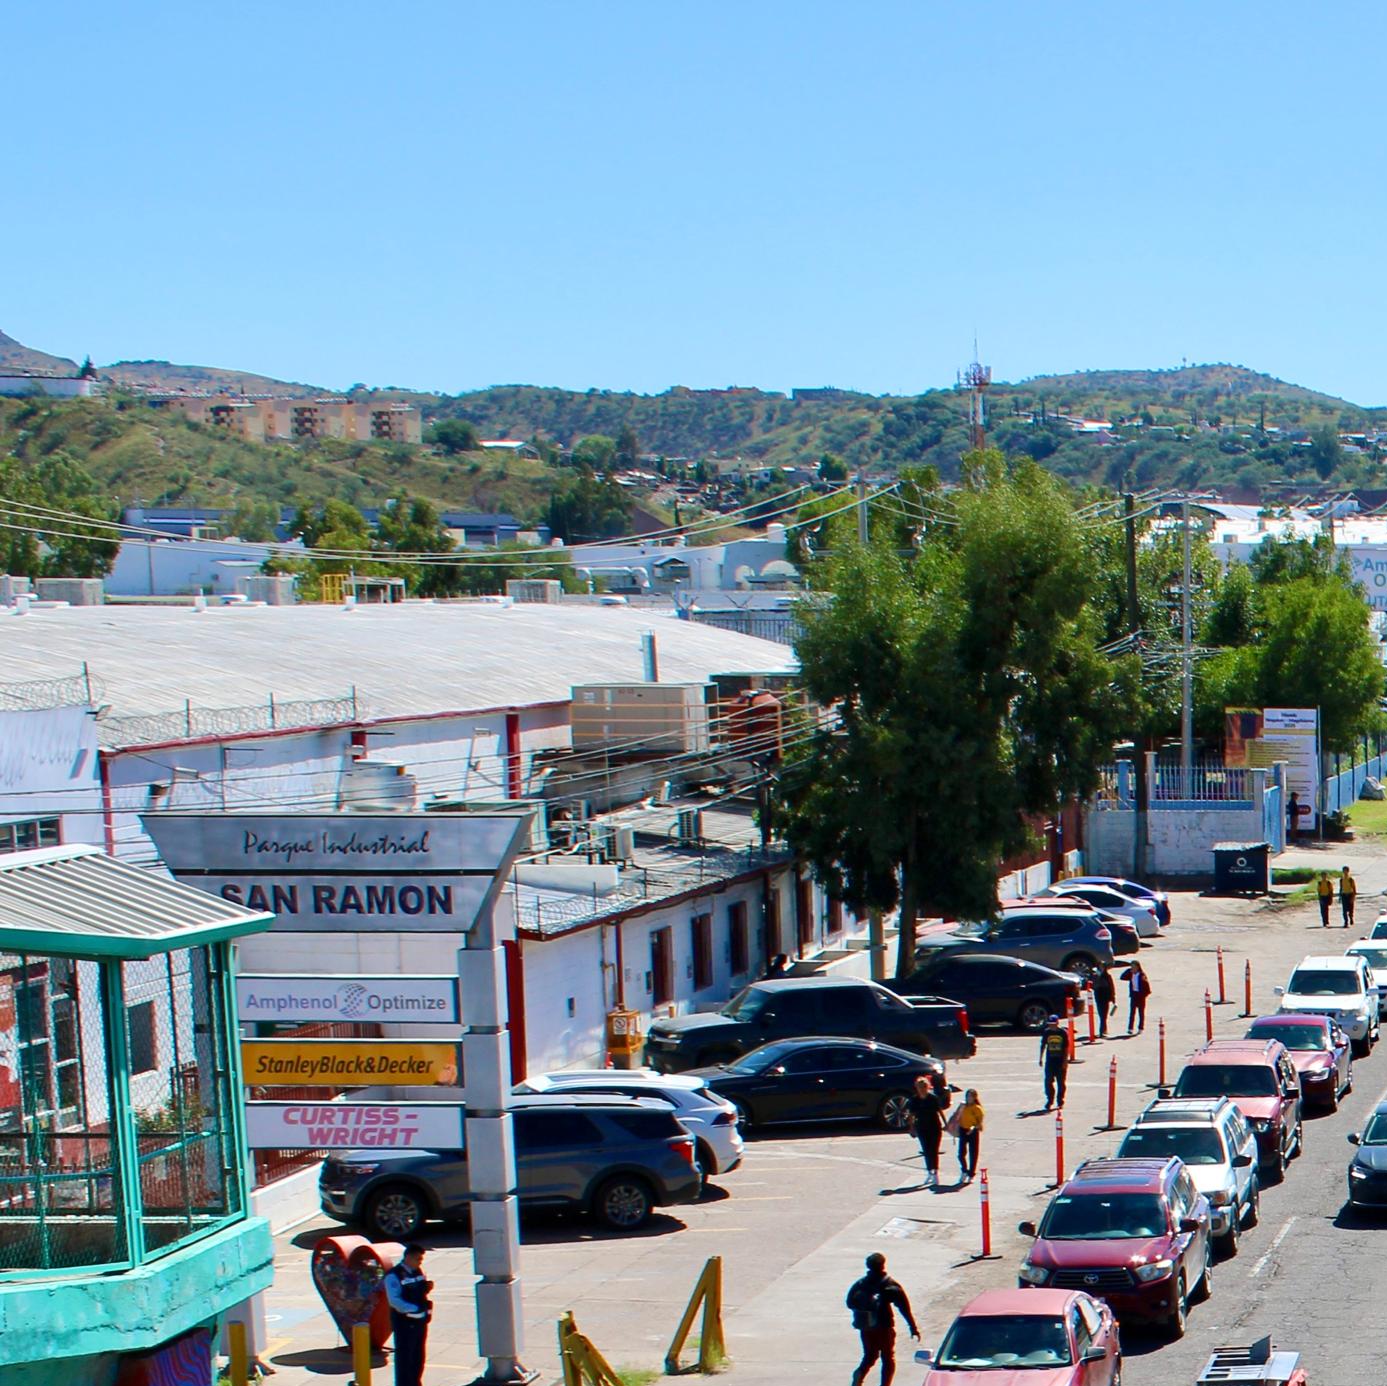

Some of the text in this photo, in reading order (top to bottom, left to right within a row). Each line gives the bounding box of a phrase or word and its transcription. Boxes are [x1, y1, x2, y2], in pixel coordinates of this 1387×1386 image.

[243, 831, 430, 862] Parque Industrial
[313, 885, 454, 915] RAMON
[245, 994, 446, 1012] Amphenol Optimize
[256, 1055, 433, 1078] StanleyBlack&Decker
[307, 1127, 419, 1146] WRIGHT
